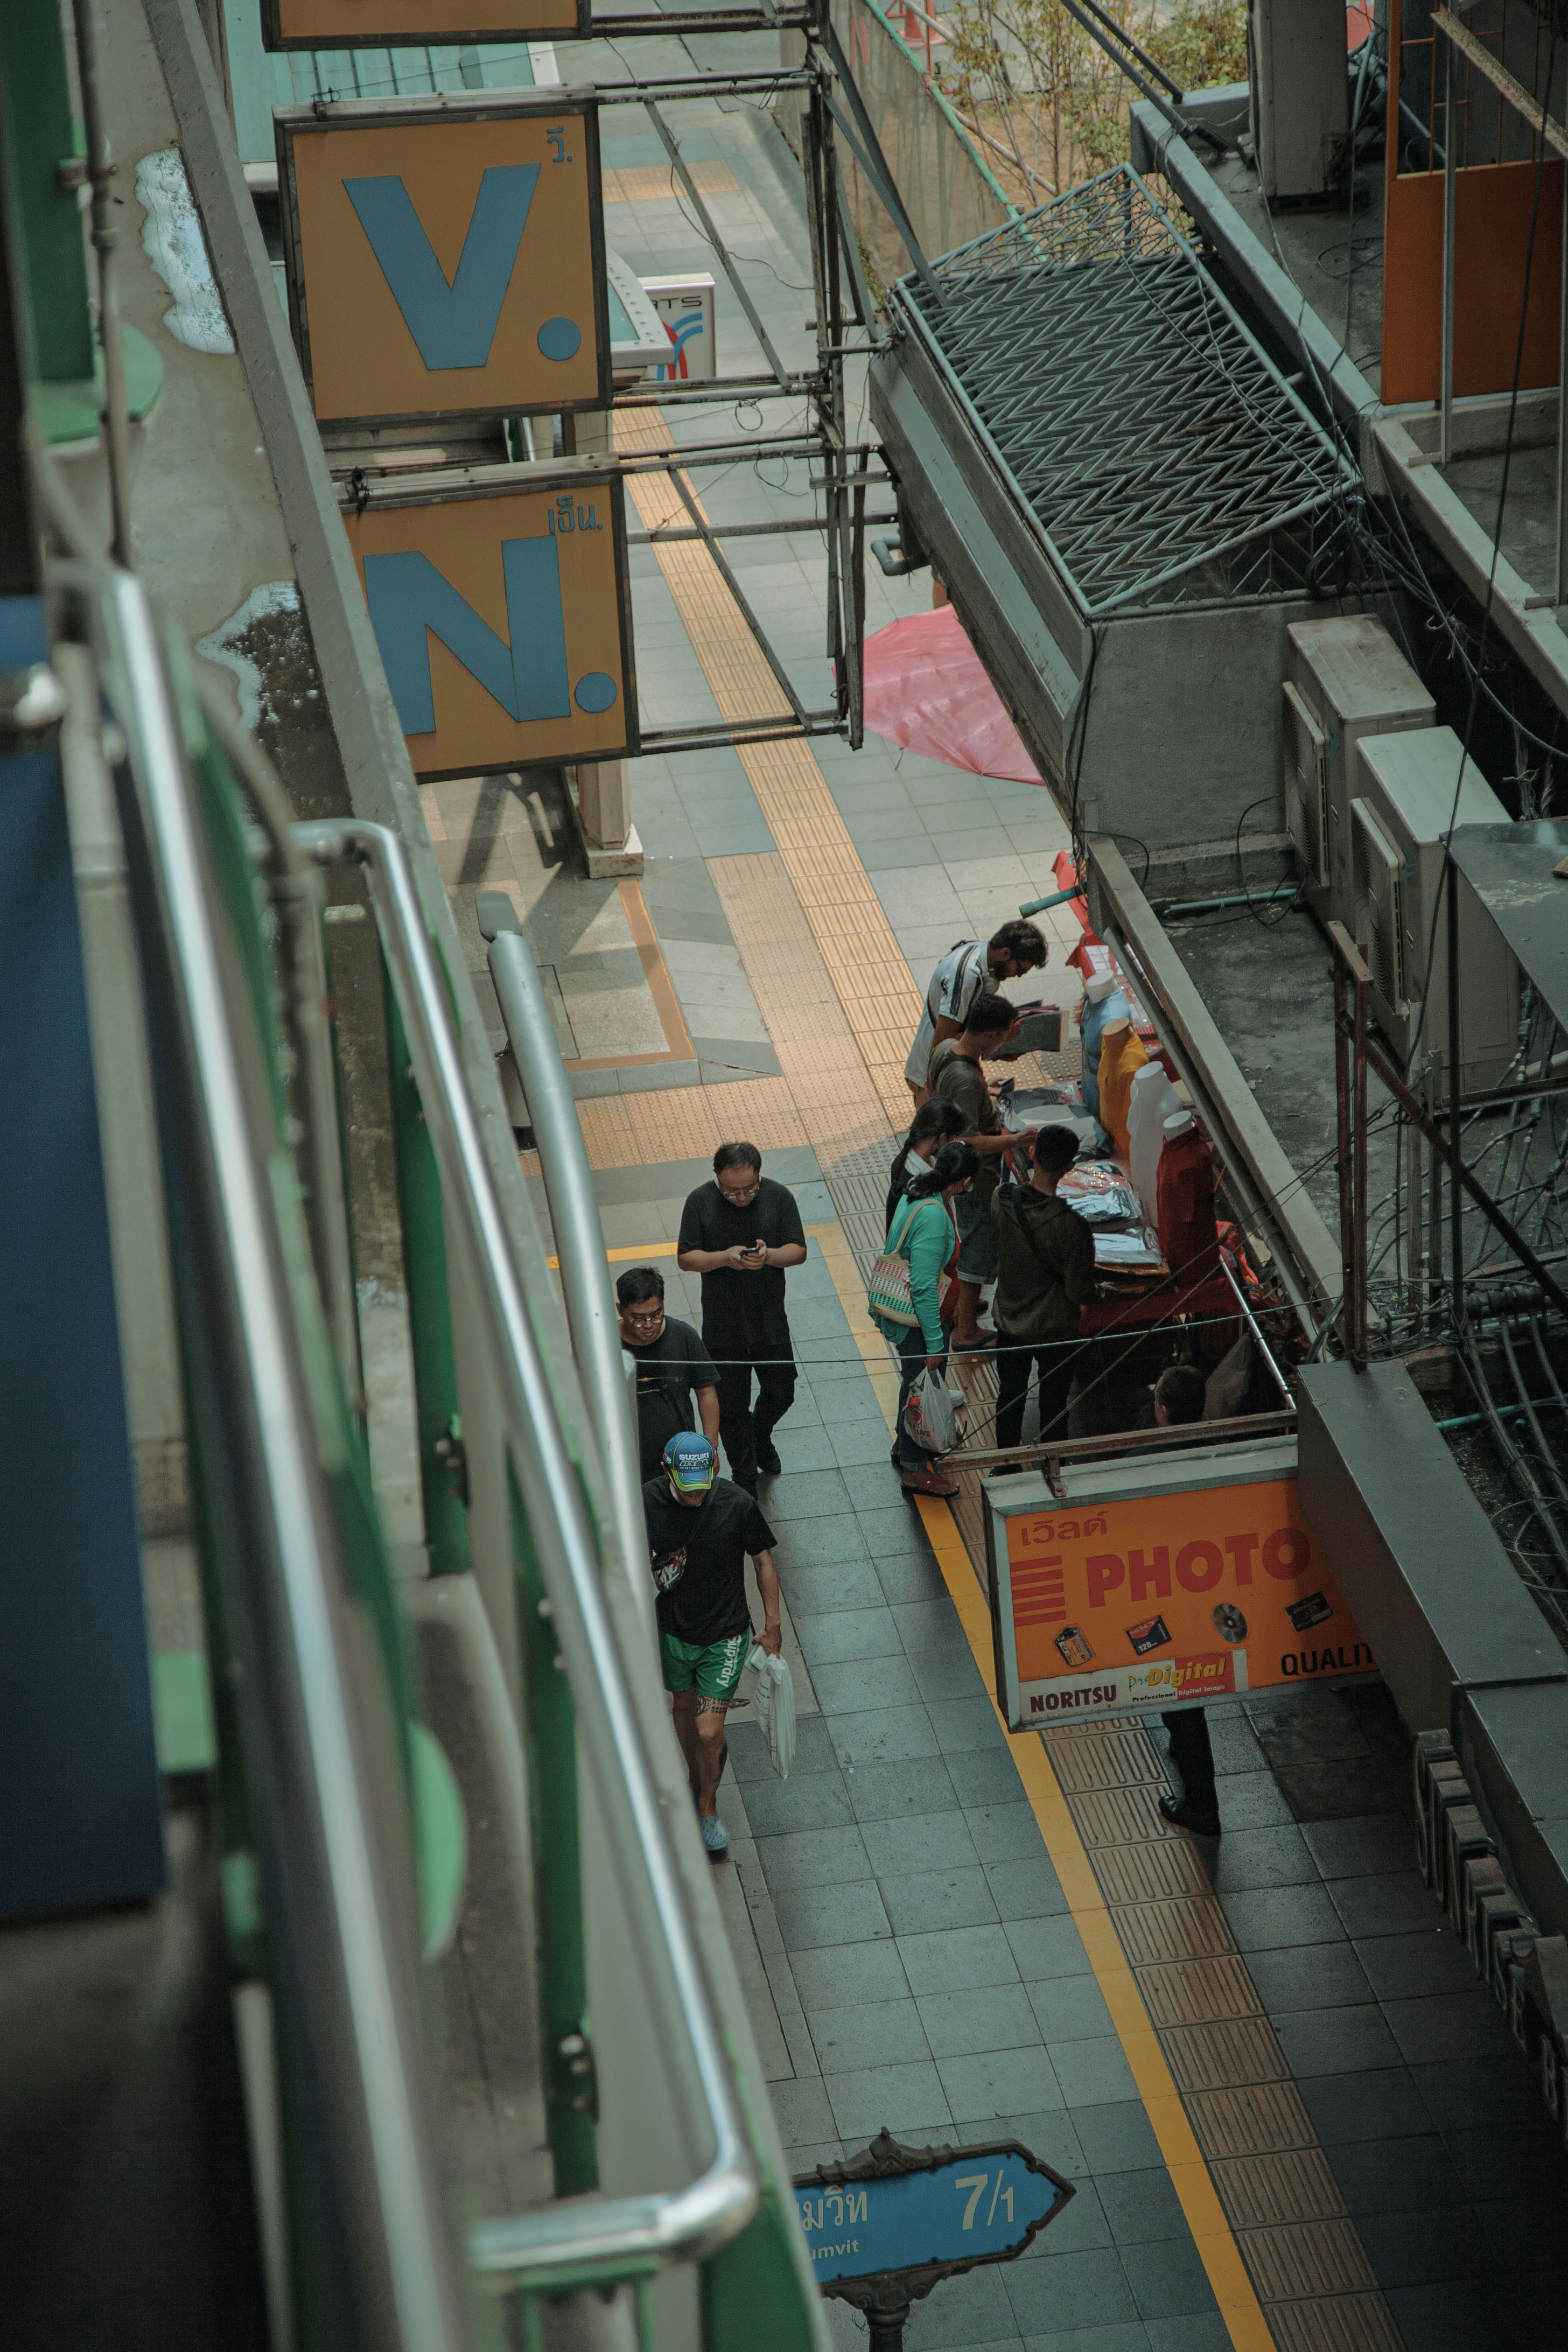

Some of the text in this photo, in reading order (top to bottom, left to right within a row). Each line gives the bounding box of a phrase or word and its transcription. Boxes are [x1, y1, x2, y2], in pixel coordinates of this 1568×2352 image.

[341, 163, 581, 370] V.
[549, 495, 603, 533] เอ็น.
[363, 534, 617, 736] N.
[678, 1452, 709, 1460] SUZUKI
[1086, 1527, 1311, 1608] PHOTO
[1138, 1641, 1152, 1652] 128
[1147, 1656, 1226, 1688] Digital
[1030, 1684, 1117, 1713] NORITSU
[1132, 1684, 1226, 1703] Professional Digital Image
[955, 2169, 1014, 2230] 7/1
